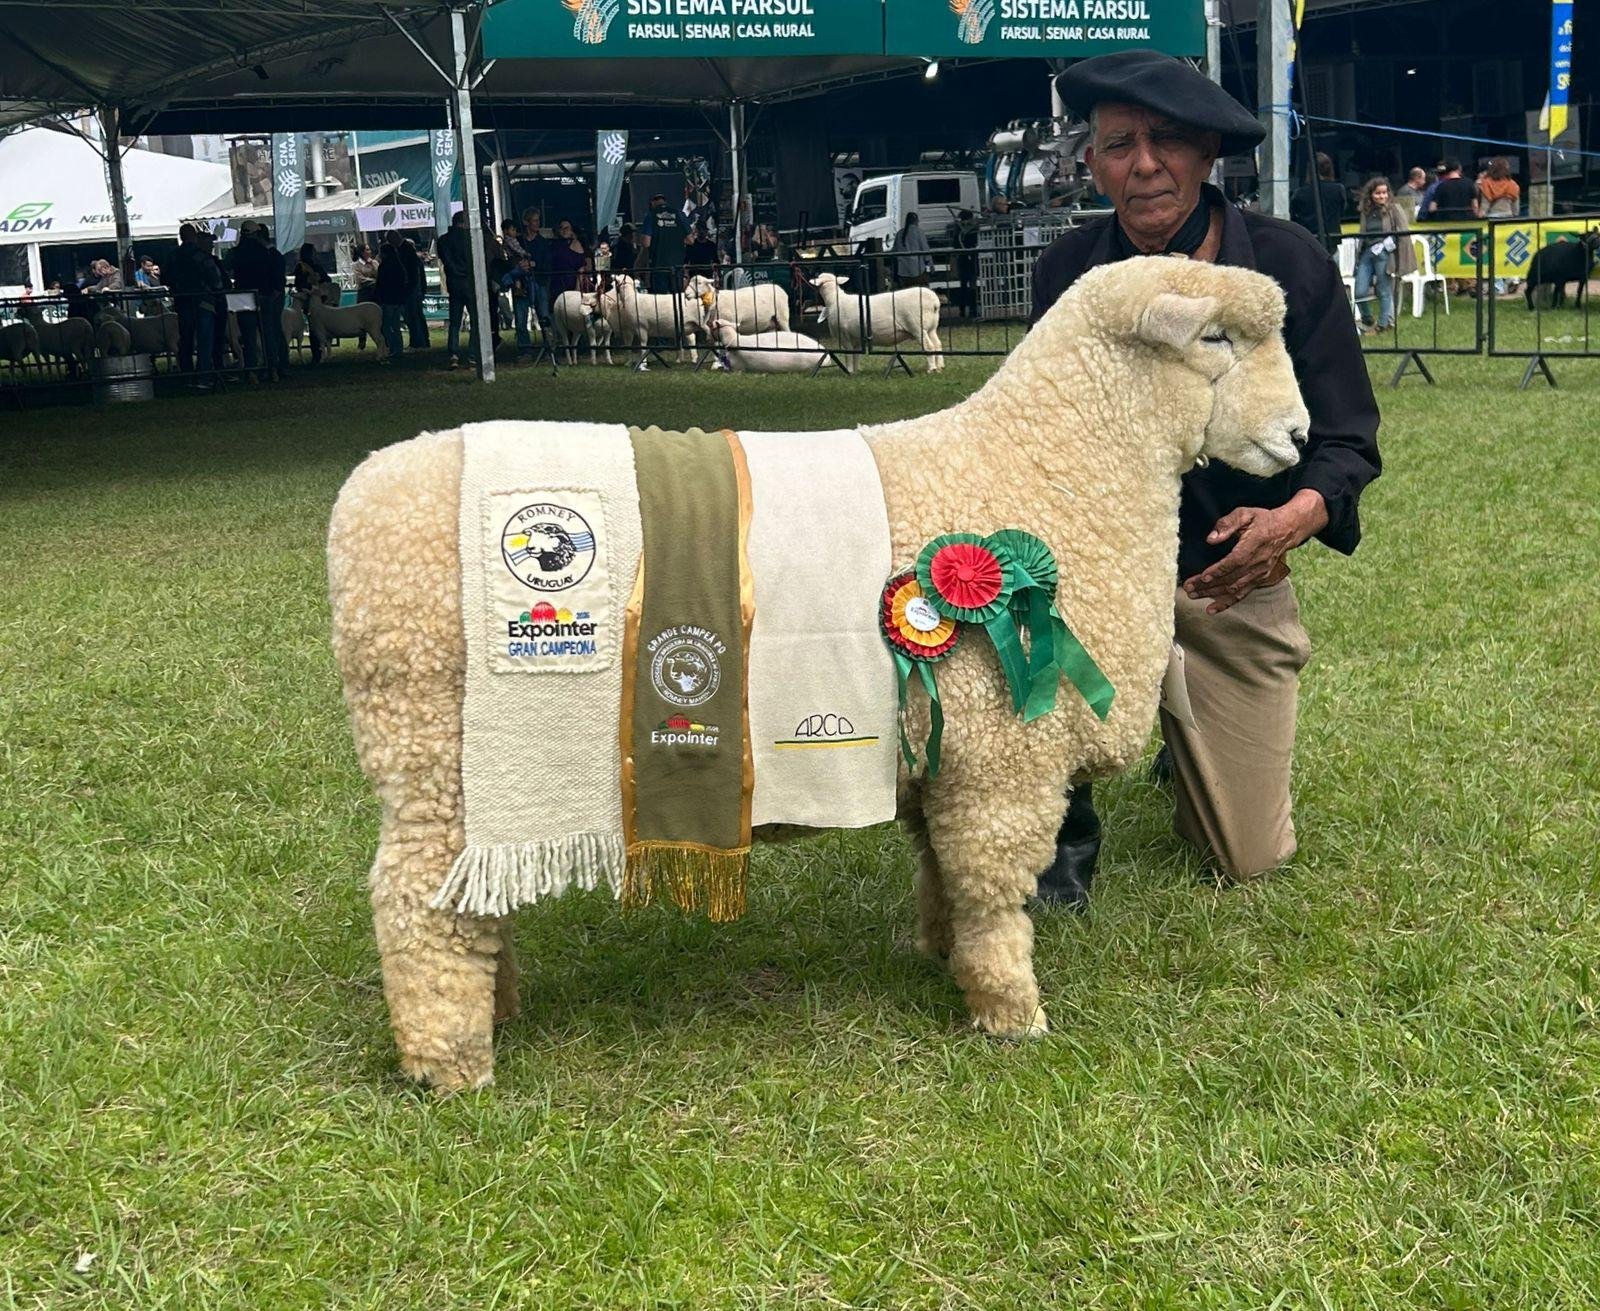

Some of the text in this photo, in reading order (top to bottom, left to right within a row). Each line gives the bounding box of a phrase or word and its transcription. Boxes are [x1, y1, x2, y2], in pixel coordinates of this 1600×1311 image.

[627, 0, 814, 15] SISTEMA FARSUL
[1000, 0, 1150, 20] SISTEMA FARSUL
[628, 24, 815, 39] FARSUL SENAR CASA RURAL
[1001, 26, 1150, 40] FARSUL SENAR CASA RURAL
[279, 141, 288, 167] CNA
[0, 217, 53, 232] ADM
[517, 507, 576, 523] ROMNEY
[526, 573, 574, 588] URUGUAY
[508, 620, 598, 641] Expointer
[647, 627, 678, 652] GRANDE
[712, 641, 727, 654] PO
[508, 641, 597, 656] GRAN CAMPEONA
[651, 730, 719, 745] Expointer
